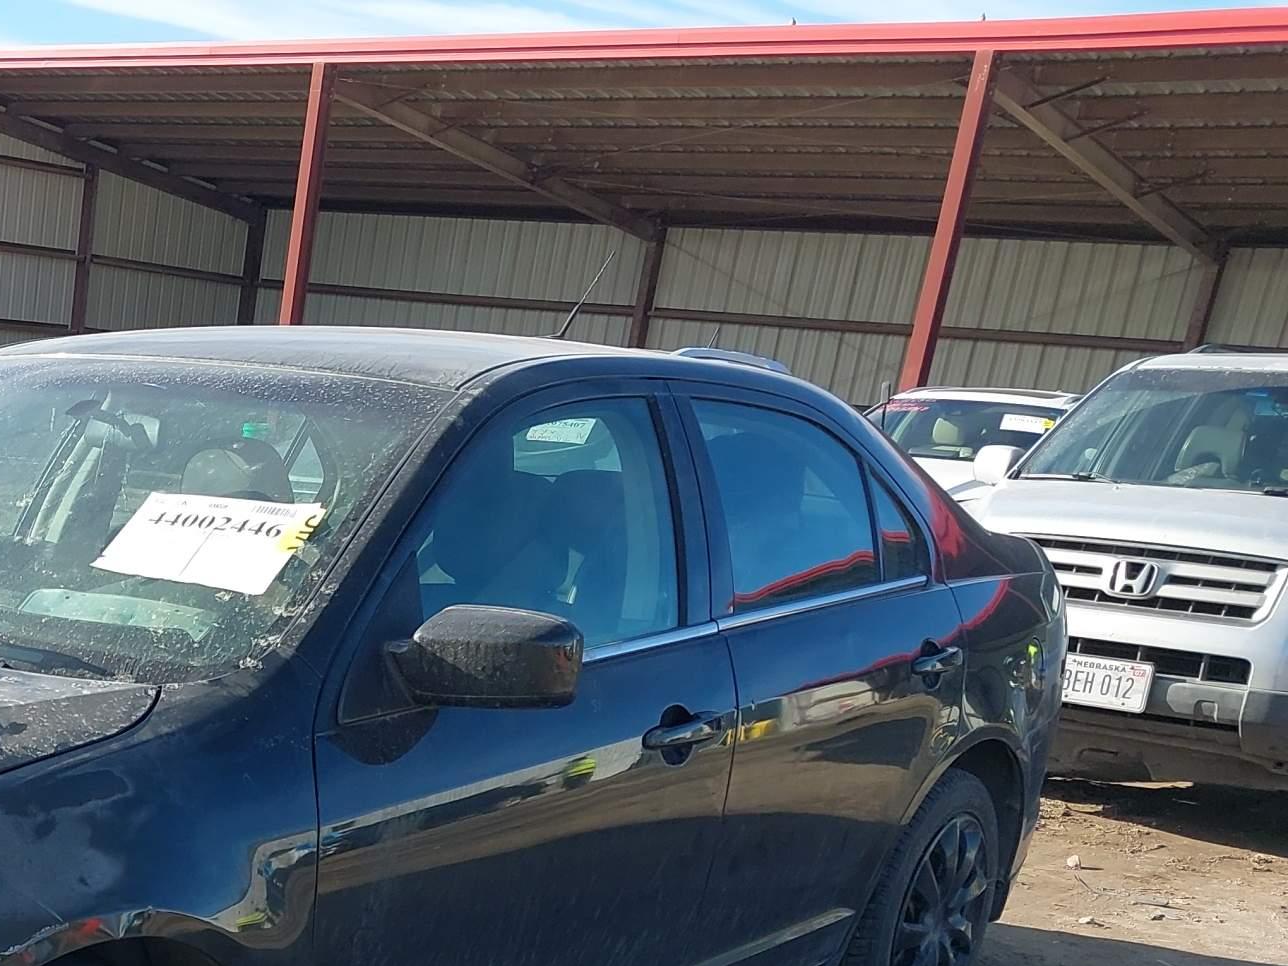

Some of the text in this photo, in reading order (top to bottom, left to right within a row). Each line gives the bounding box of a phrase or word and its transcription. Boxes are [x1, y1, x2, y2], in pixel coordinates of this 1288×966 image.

[147, 510, 286, 539] 44002446
[1076, 660, 1127, 674] NEBRASKA
[1099, 674, 1135, 700] 012
